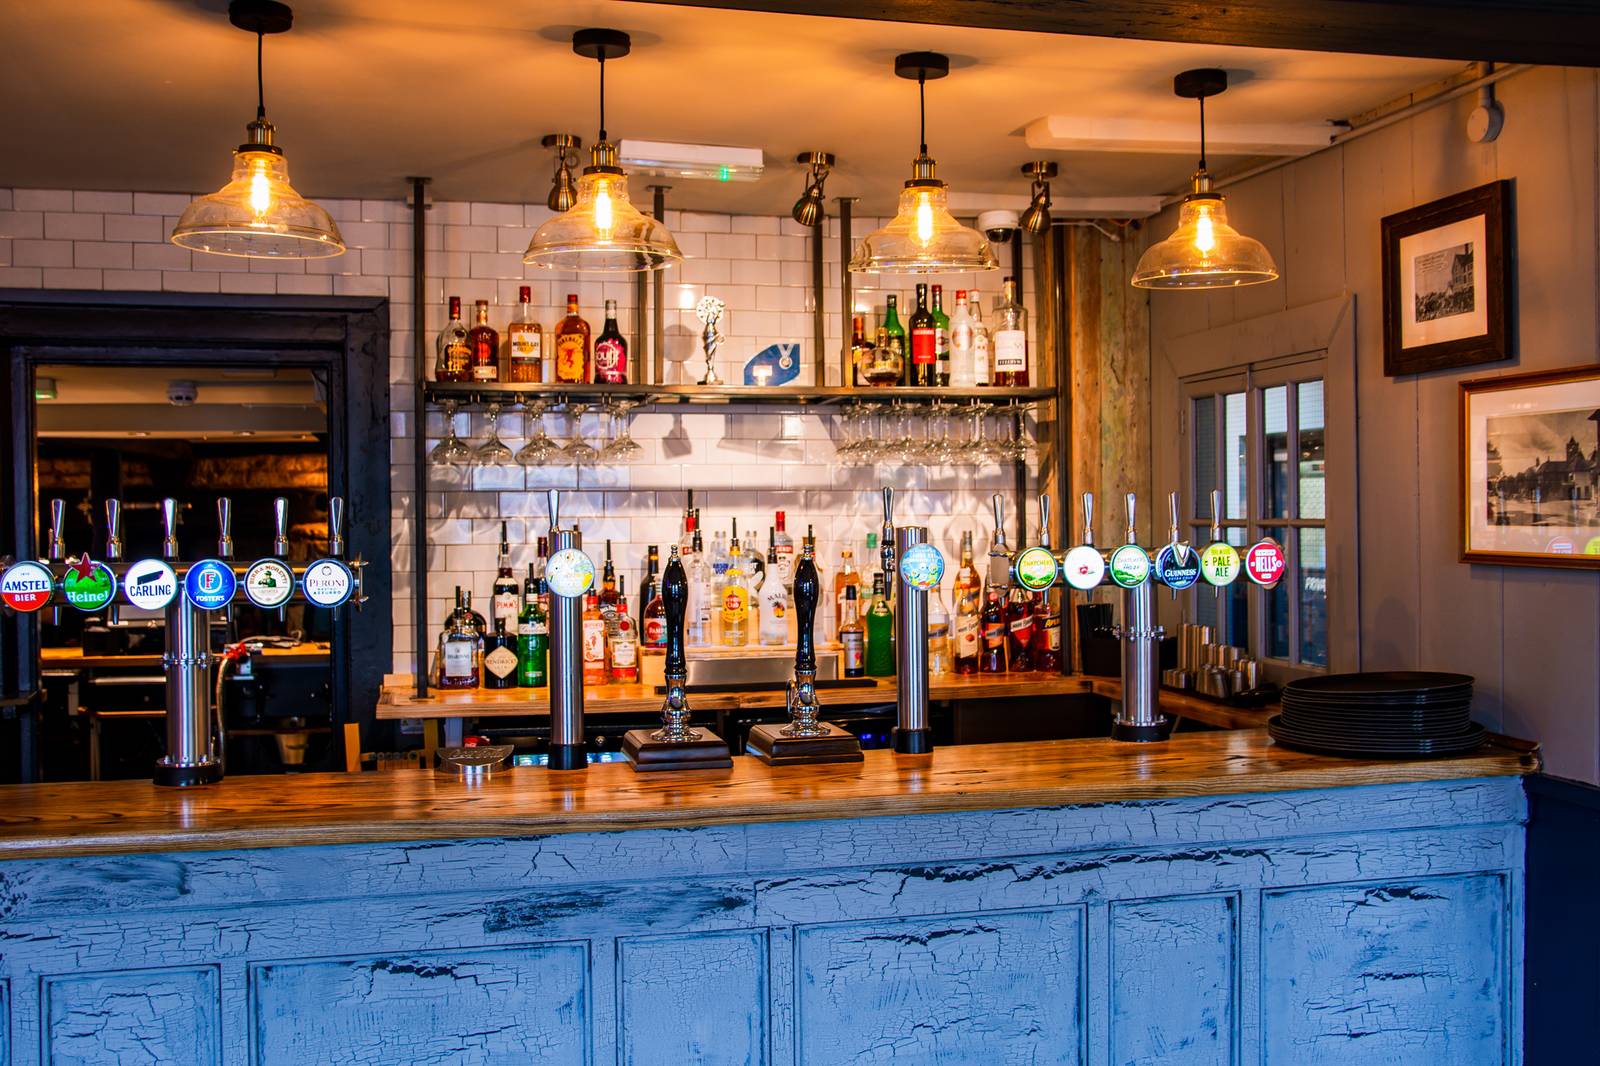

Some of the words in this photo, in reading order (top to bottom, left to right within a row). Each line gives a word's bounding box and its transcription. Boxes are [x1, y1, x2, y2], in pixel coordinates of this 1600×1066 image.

[1212, 556, 1231, 566] PALE
[1255, 556, 1278, 573] HELLS
[1164, 568, 1197, 577] GUINNESS
[1215, 566, 1230, 577] ALE
[4, 580, 47, 591] AMSTEL
[309, 579, 345, 587] PERONI
[130, 584, 171, 597] CARLING
[15, 594, 36, 602] BIER
